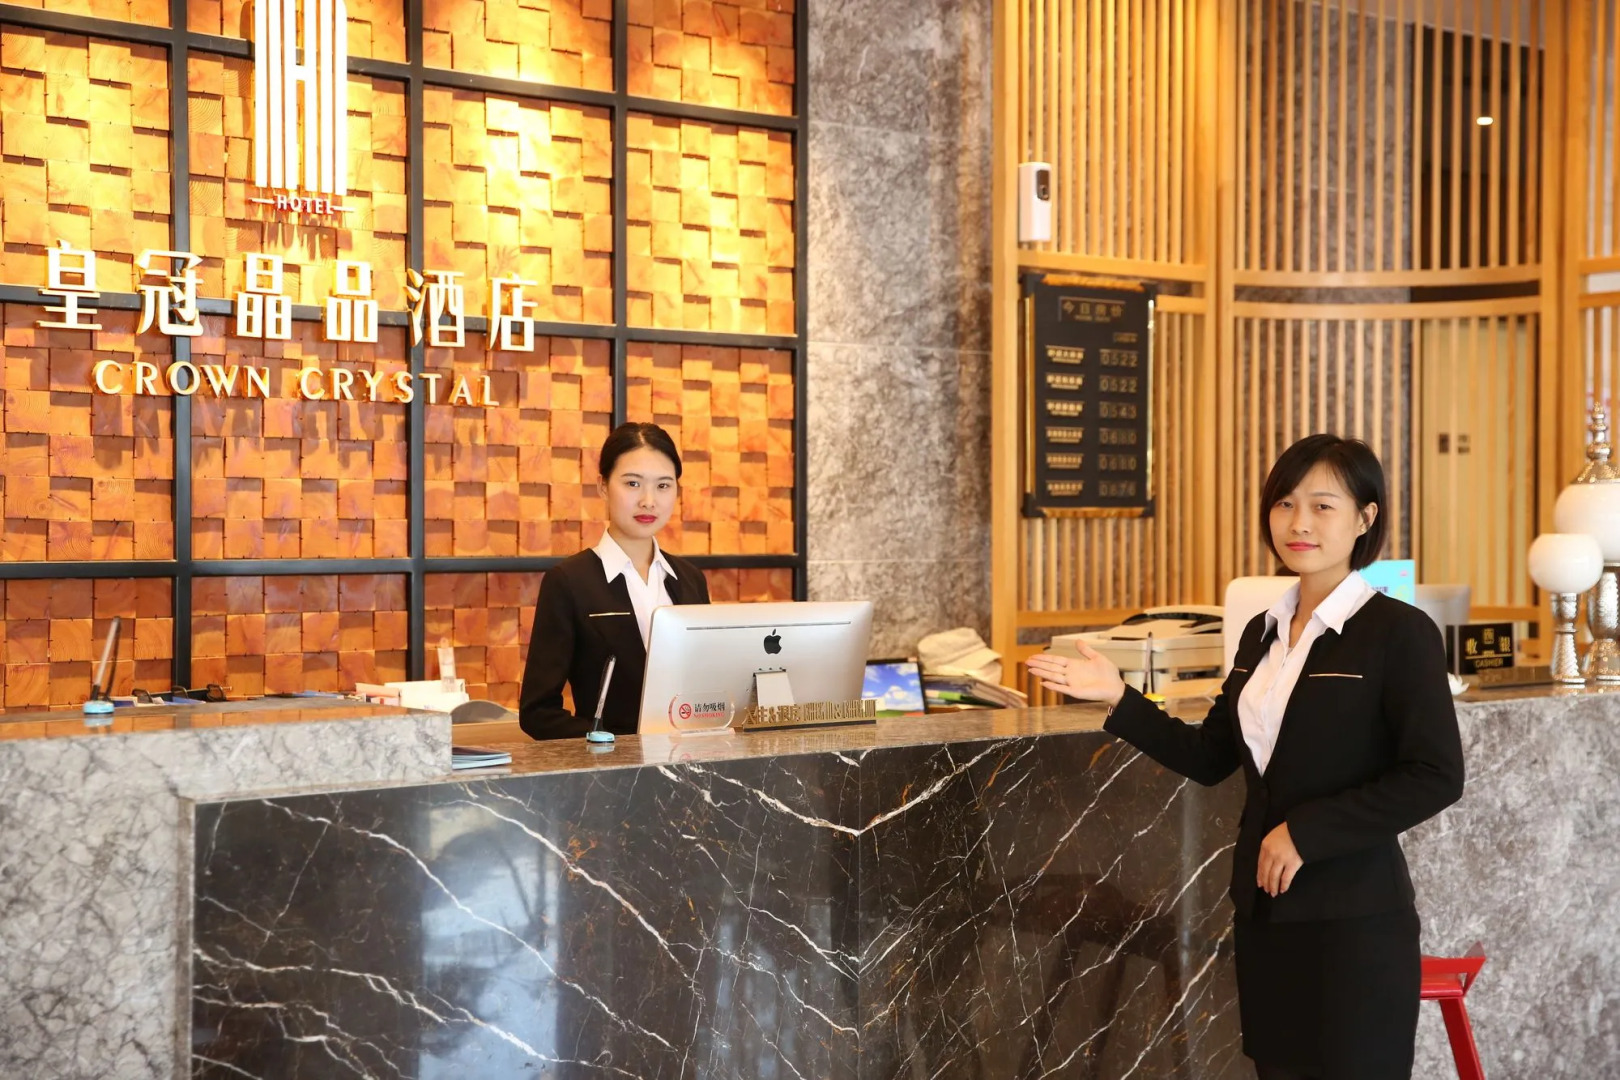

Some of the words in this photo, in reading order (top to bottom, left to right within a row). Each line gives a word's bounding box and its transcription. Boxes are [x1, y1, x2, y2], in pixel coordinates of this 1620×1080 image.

[276, 194, 334, 215] HOTEL
[36, 239, 538, 352] 皇冠晶品酒店
[92, 359, 271, 399] CROWN
[299, 367, 500, 407] CRYSTAL
[1474, 658, 1504, 668] CASHIER
[694, 702, 726, 713] 请勿吸烟
